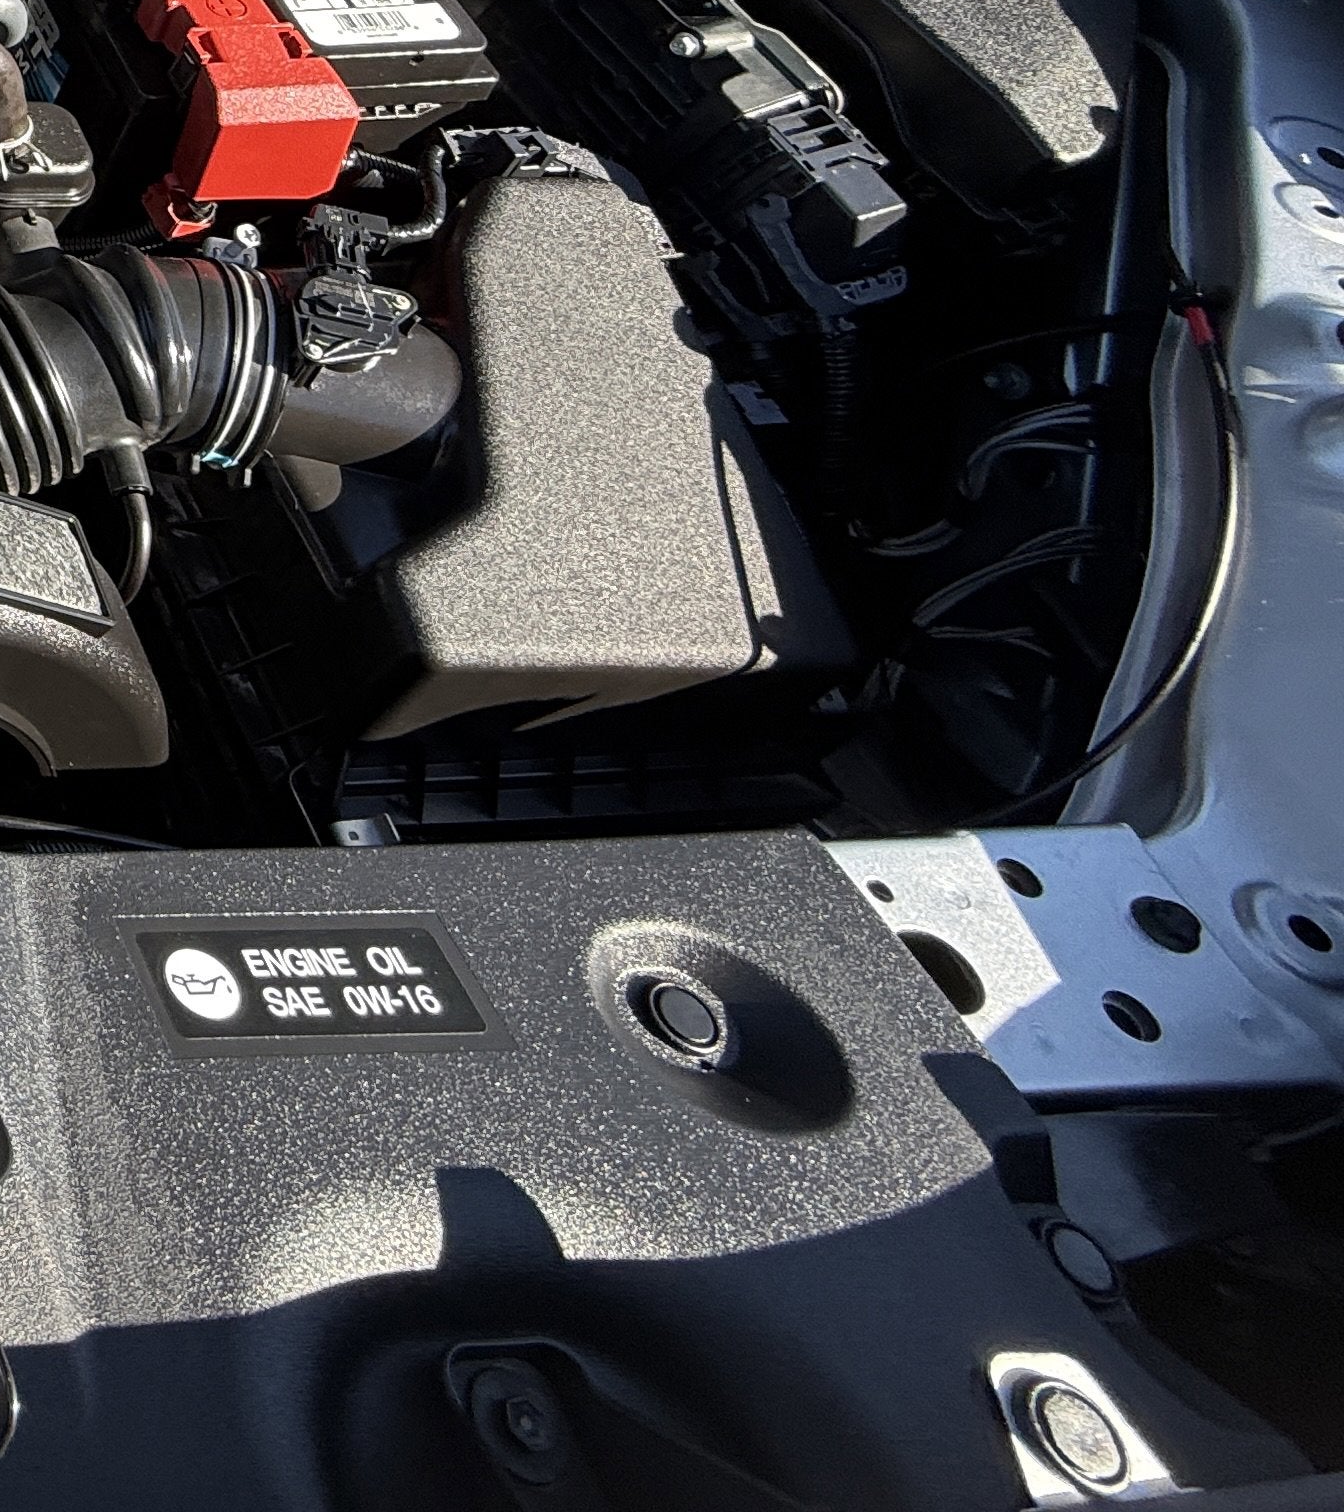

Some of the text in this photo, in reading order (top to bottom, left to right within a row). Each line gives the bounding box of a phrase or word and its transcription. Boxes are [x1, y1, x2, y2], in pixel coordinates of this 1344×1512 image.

[241, 945, 423, 978] ENGINE OIL
[263, 984, 442, 1018] SAE 0W-16
